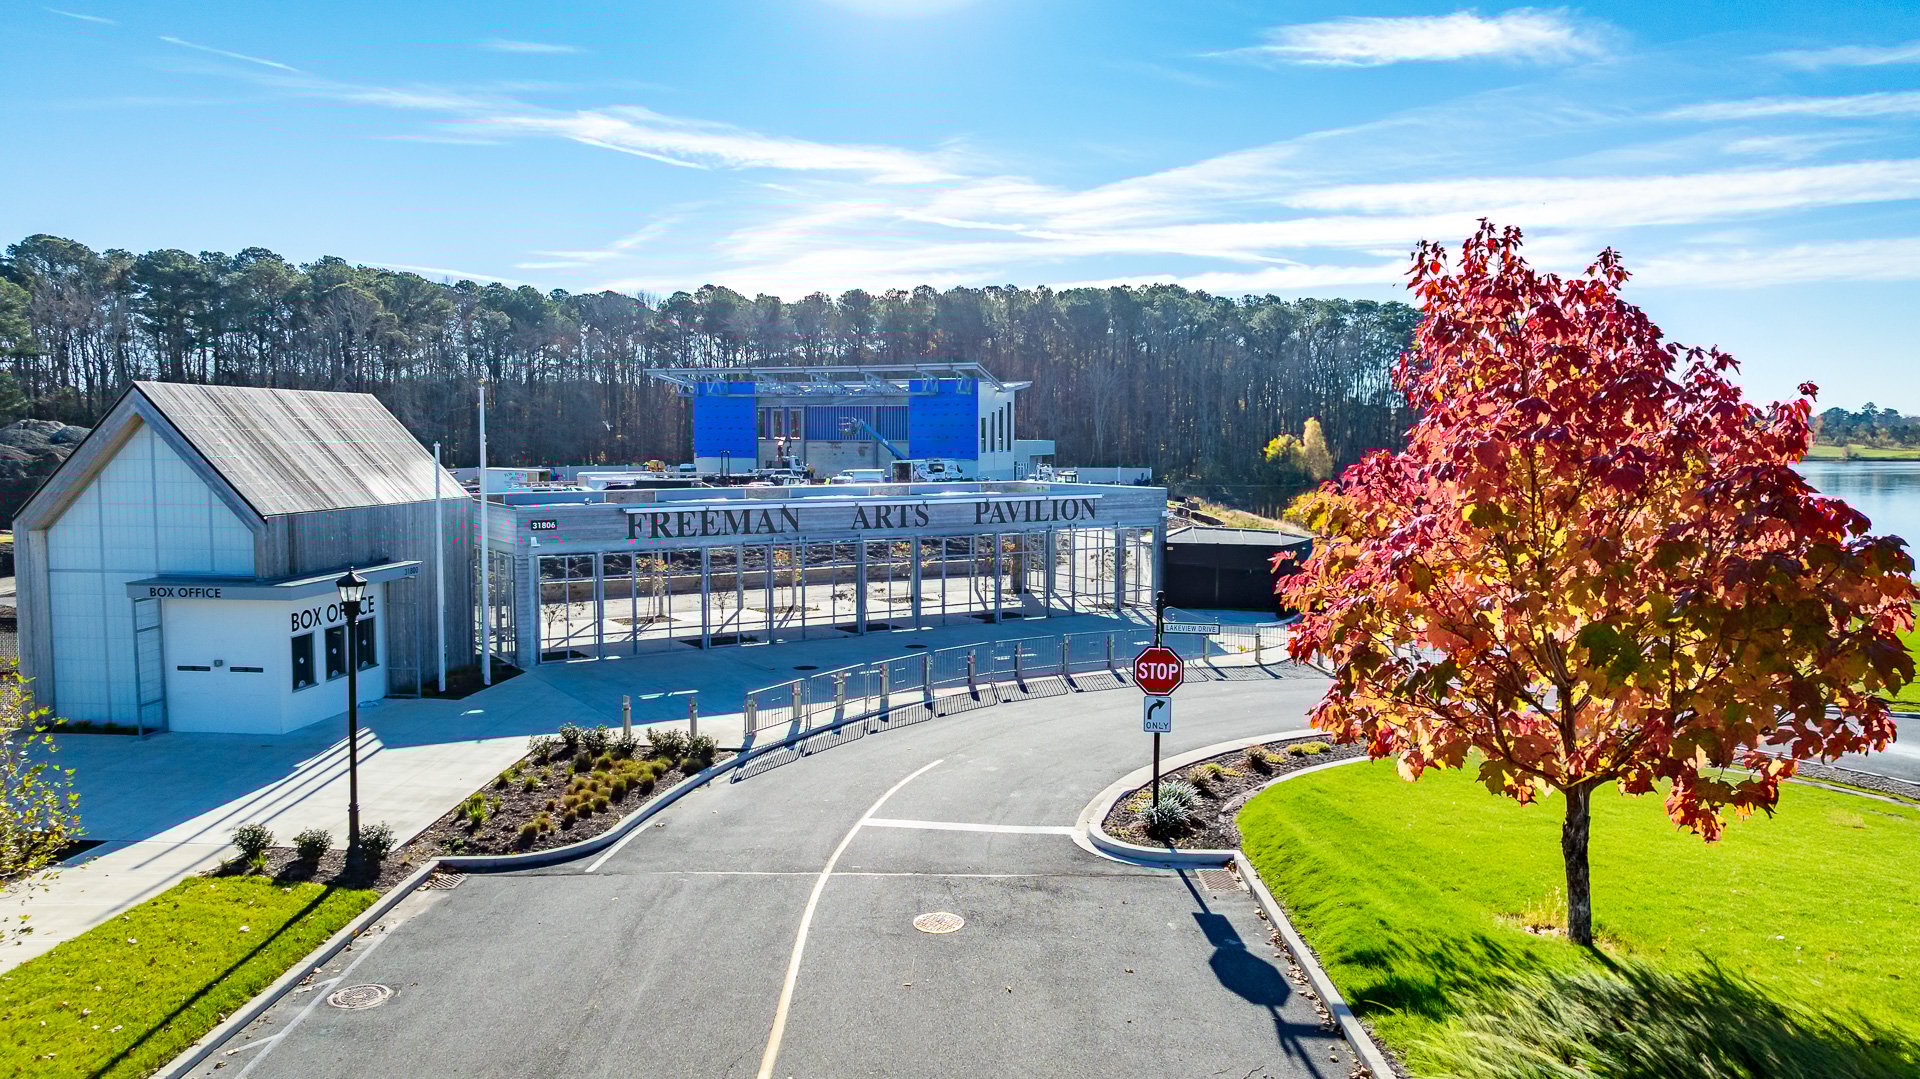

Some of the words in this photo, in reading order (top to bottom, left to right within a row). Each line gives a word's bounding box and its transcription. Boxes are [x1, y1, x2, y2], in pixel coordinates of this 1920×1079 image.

[532, 522, 556, 530] 31806
[626, 508, 799, 539] FREEMAN
[851, 503, 930, 530] ARTS
[975, 499, 1097, 525] PAVILION
[150, 587, 174, 598] BOX
[178, 587, 221, 598] OFFICE
[291, 607, 321, 632] BOX
[326, 595, 374, 622] OFCE
[1138, 662, 1179, 680] STOP
[1146, 721, 1169, 729] ONLY
